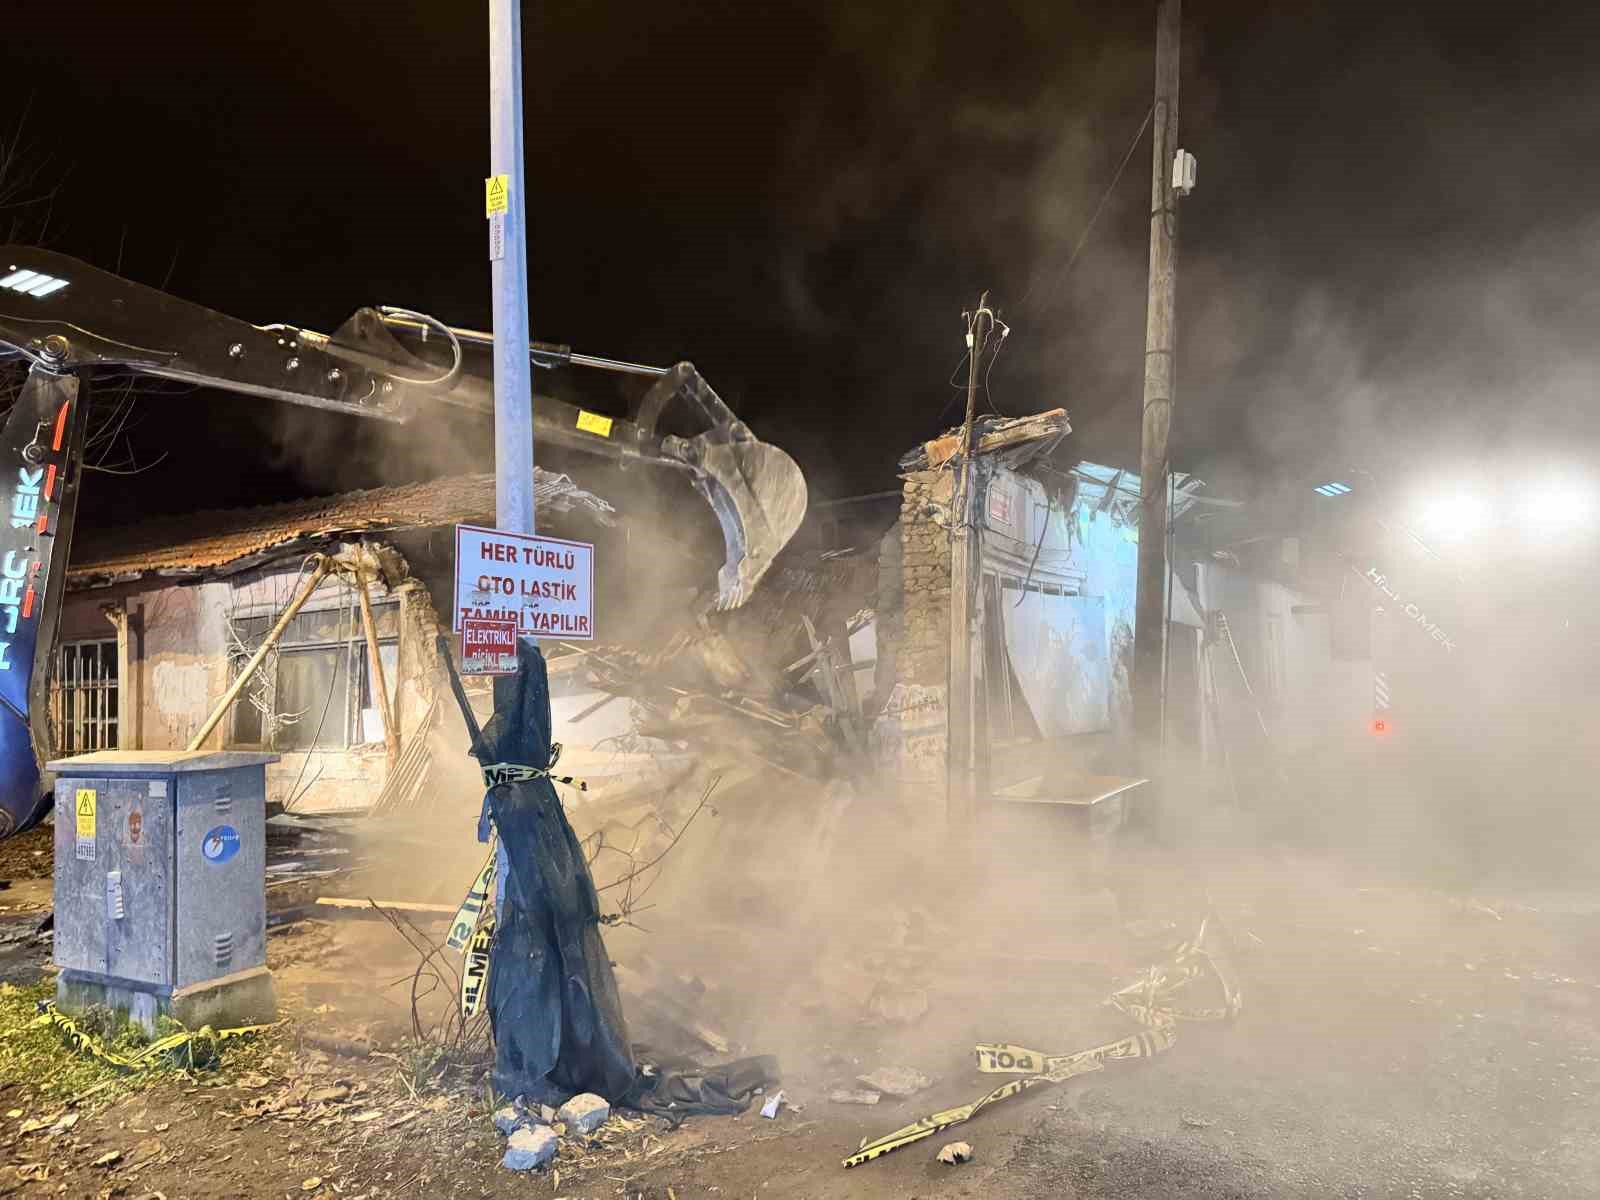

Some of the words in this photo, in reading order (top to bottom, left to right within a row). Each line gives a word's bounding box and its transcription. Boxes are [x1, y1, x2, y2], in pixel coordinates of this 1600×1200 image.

[480, 541, 518, 564] HER
[522, 545, 575, 570] TÜRLÜ
[477, 575, 515, 596] OTO
[520, 579, 577, 601] LASTİK
[531, 612, 588, 632] YAPILIR
